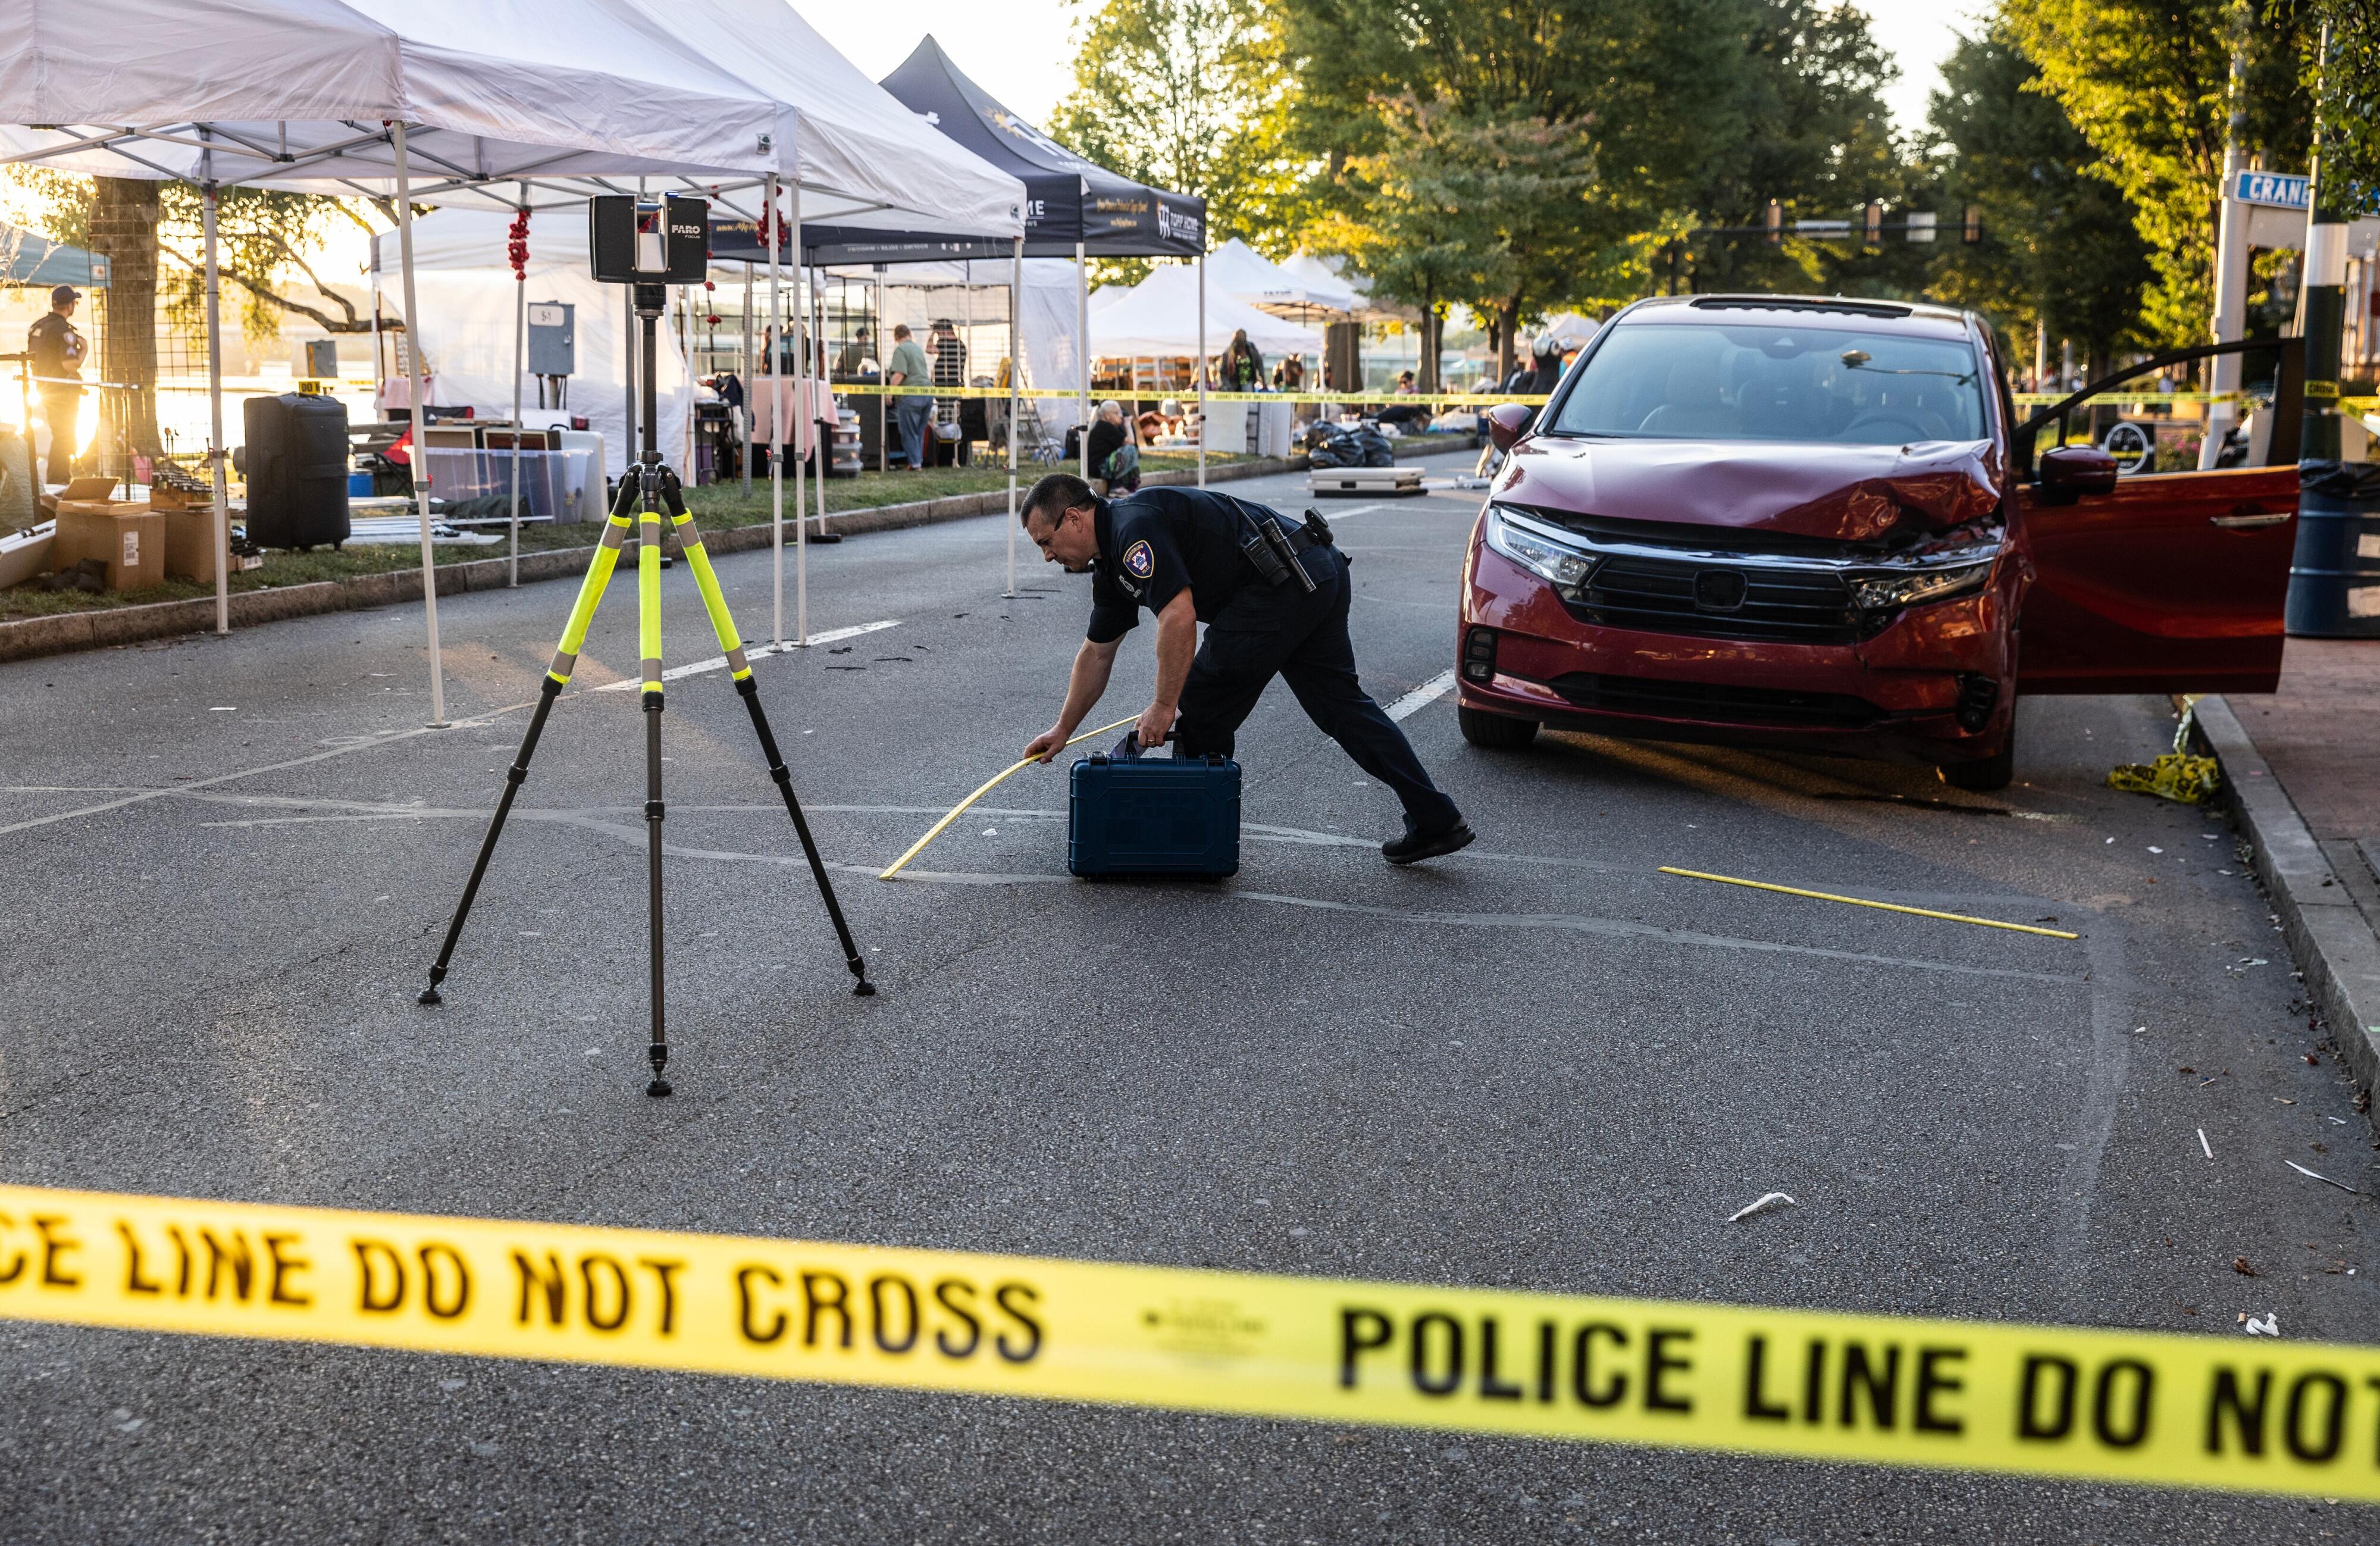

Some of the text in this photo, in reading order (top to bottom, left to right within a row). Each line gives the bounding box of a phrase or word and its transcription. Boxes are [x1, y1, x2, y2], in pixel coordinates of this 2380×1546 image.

[672, 224, 700, 234] FARO
[1126, 543, 1144, 562] HARRISBURG
[117, 1220, 311, 1307] LINE
[352, 1241, 470, 1320] DO
[513, 1250, 685, 1335] NOT
[735, 1265, 1044, 1365] CROSS
[1338, 1306, 1696, 1419] POLICE
[1740, 1333, 1969, 1440] LINE
[2012, 1351, 2159, 1454] DO
